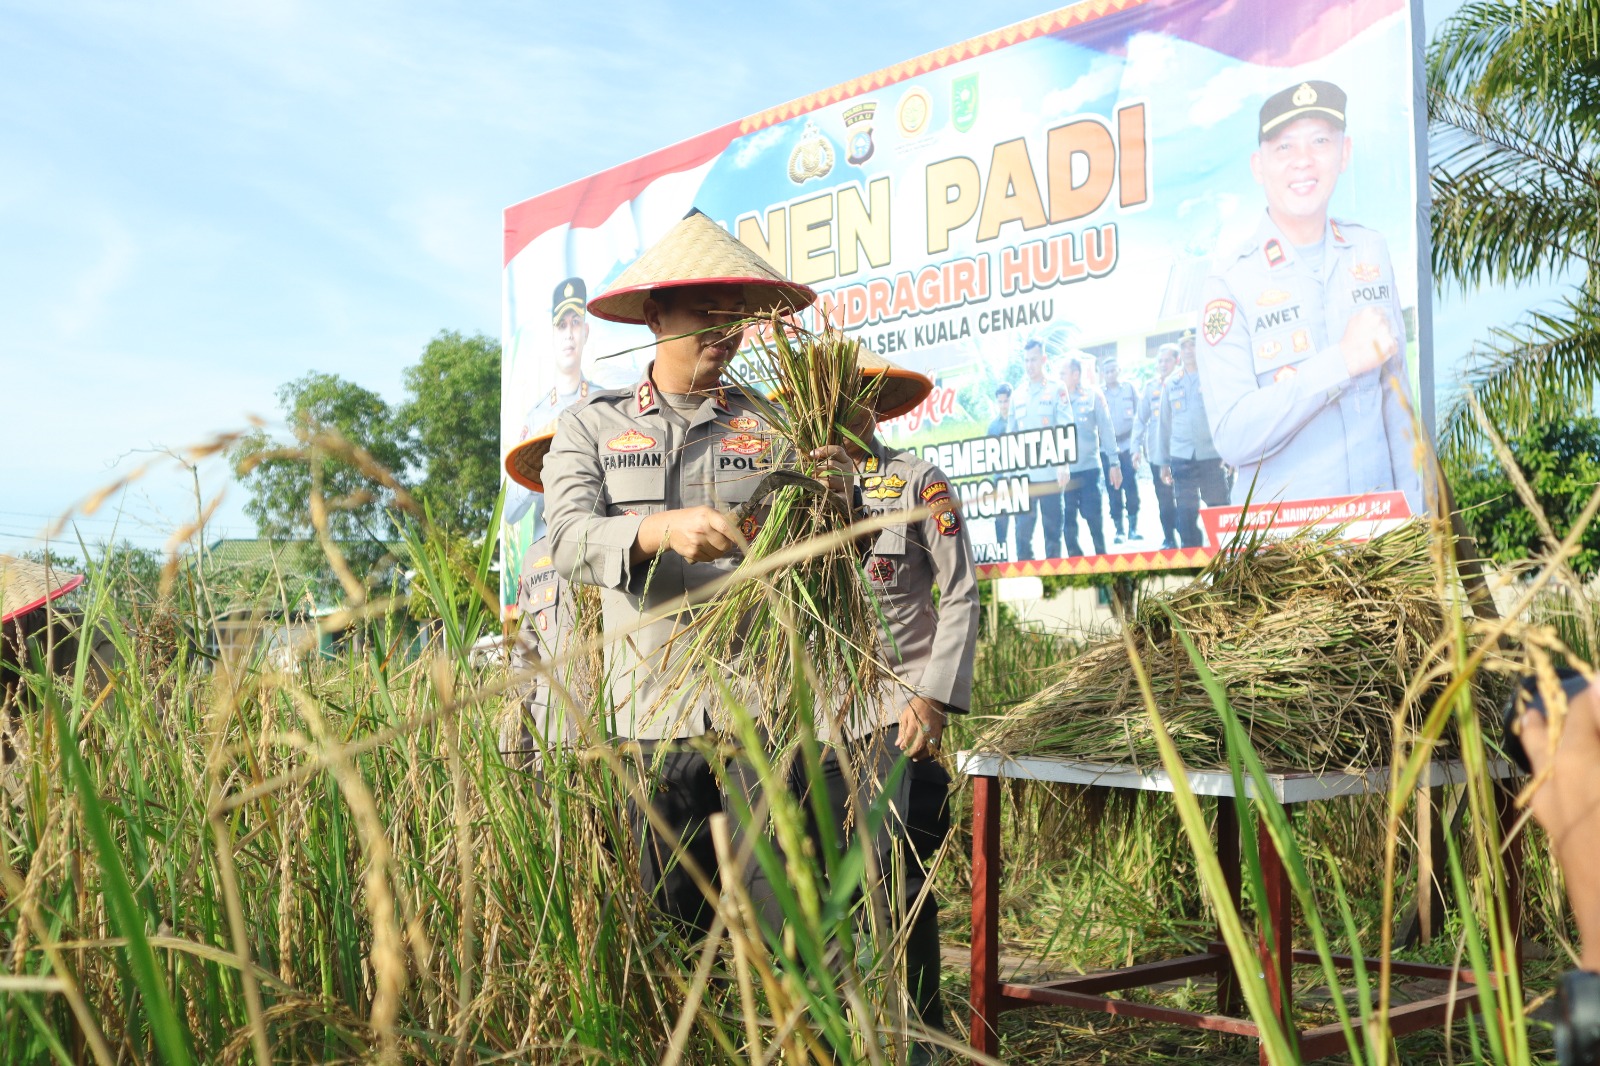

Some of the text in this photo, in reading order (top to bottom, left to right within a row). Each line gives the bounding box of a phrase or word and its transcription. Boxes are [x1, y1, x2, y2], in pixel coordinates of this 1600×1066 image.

[739, 102, 1148, 285] NEN PADI
[812, 254, 990, 334] INDRAGIRI
[1001, 223, 1118, 296] HULU
[1351, 285, 1390, 304] POLRI
[860, 299, 1055, 355] OLSEK KUALA CENAKU
[1254, 305, 1300, 333] AWET
[603, 452, 662, 471] FAHRIAN
[922, 424, 1078, 478] PEMERINTAH
[955, 477, 1030, 519] NGAN
[971, 542, 1009, 564] WAH
[530, 569, 557, 588] AWET
